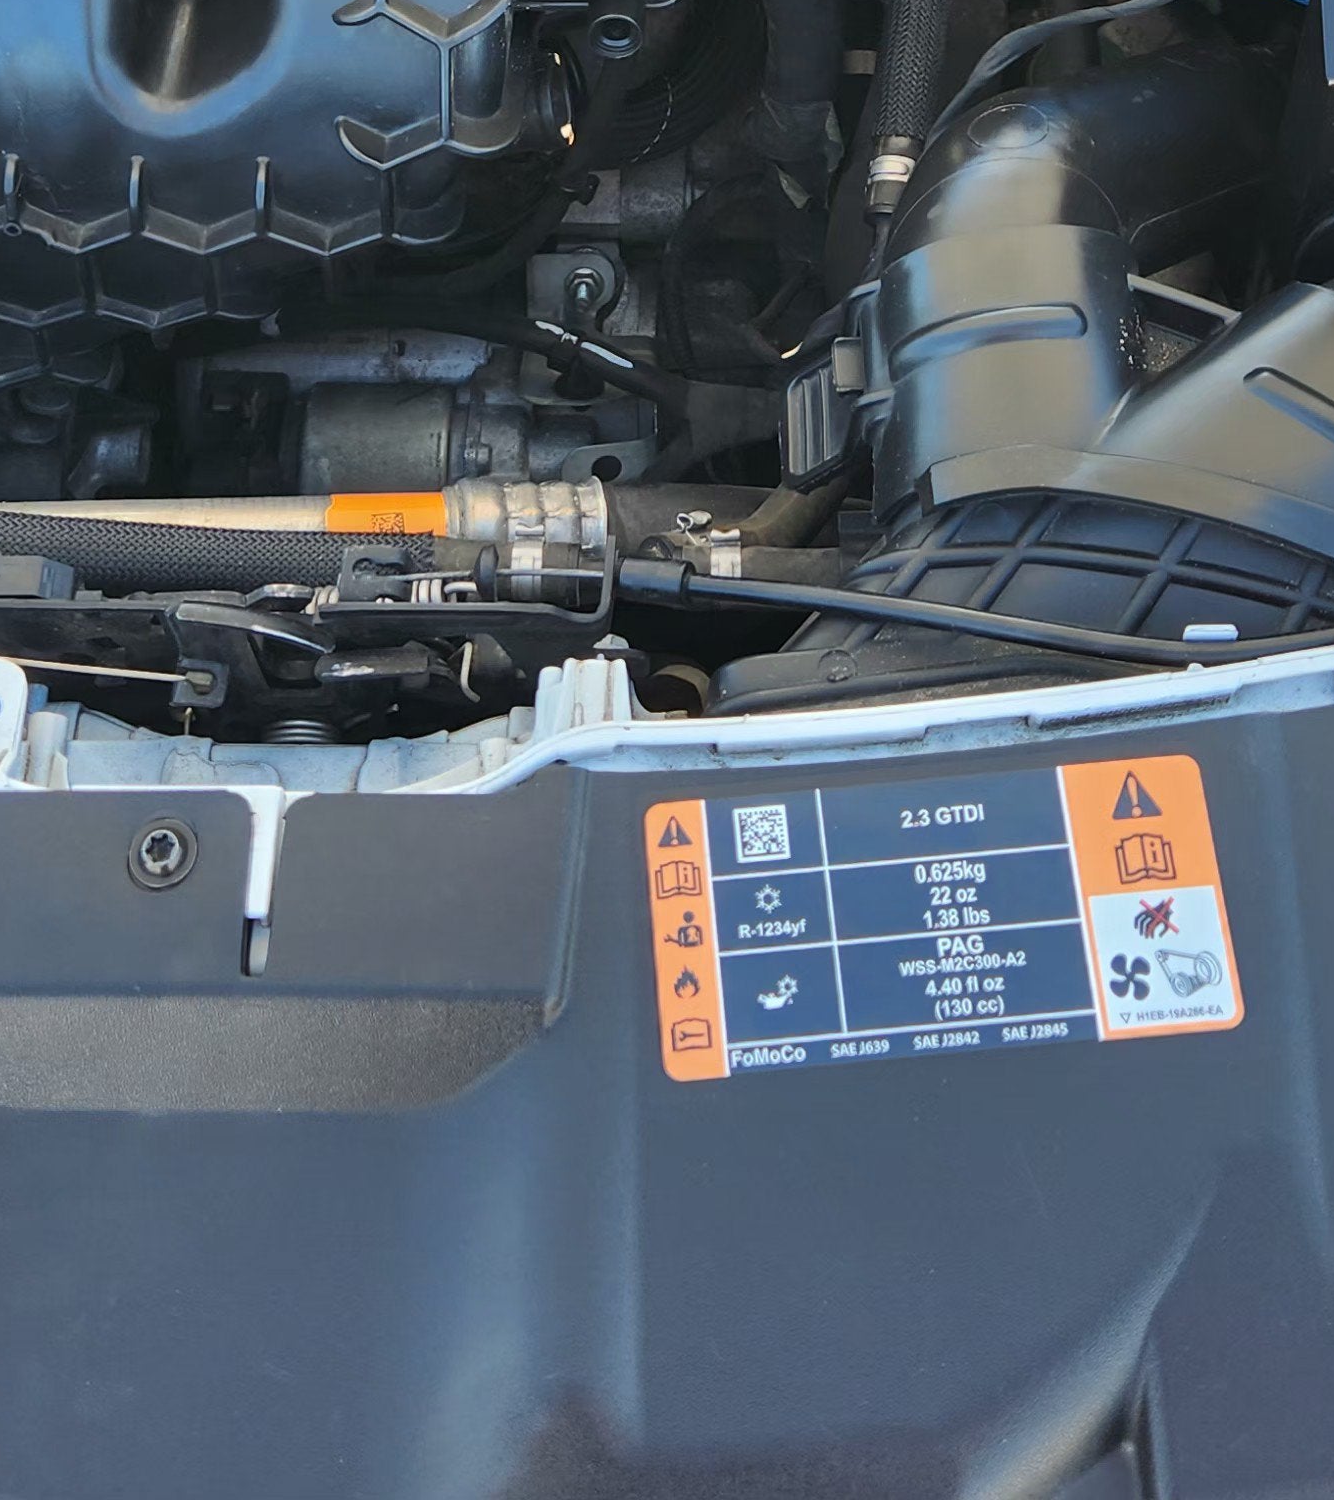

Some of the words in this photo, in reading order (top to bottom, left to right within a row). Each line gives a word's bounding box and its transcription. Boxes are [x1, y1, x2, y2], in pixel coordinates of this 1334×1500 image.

[900, 809, 931, 829] 2.3
[935, 804, 985, 825] GTDI
[914, 860, 987, 884] 0.625kg
[930, 887, 953, 906] 22
[955, 887, 978, 904] oz
[737, 918, 807, 939] R-1234yf
[923, 909, 959, 930] 1.38
[962, 906, 991, 927] lbs
[936, 934, 984, 958] PAG
[898, 950, 1028, 978] WSS-M2C300-A2
[925, 977, 962, 998] 4.40
[982, 977, 1005, 992] oz
[934, 997, 973, 1022] (130
[975, 994, 1005, 1017] cc)
[912, 1034, 939, 1051] SAE
[941, 1030, 981, 1049] J2842
[1002, 1025, 1028, 1043] SAE
[1030, 1021, 1069, 1041] J2845
[730, 1045, 807, 1068] FoMoCo
[830, 1042, 856, 1059] SAE
[857, 1039, 890, 1058] J639
